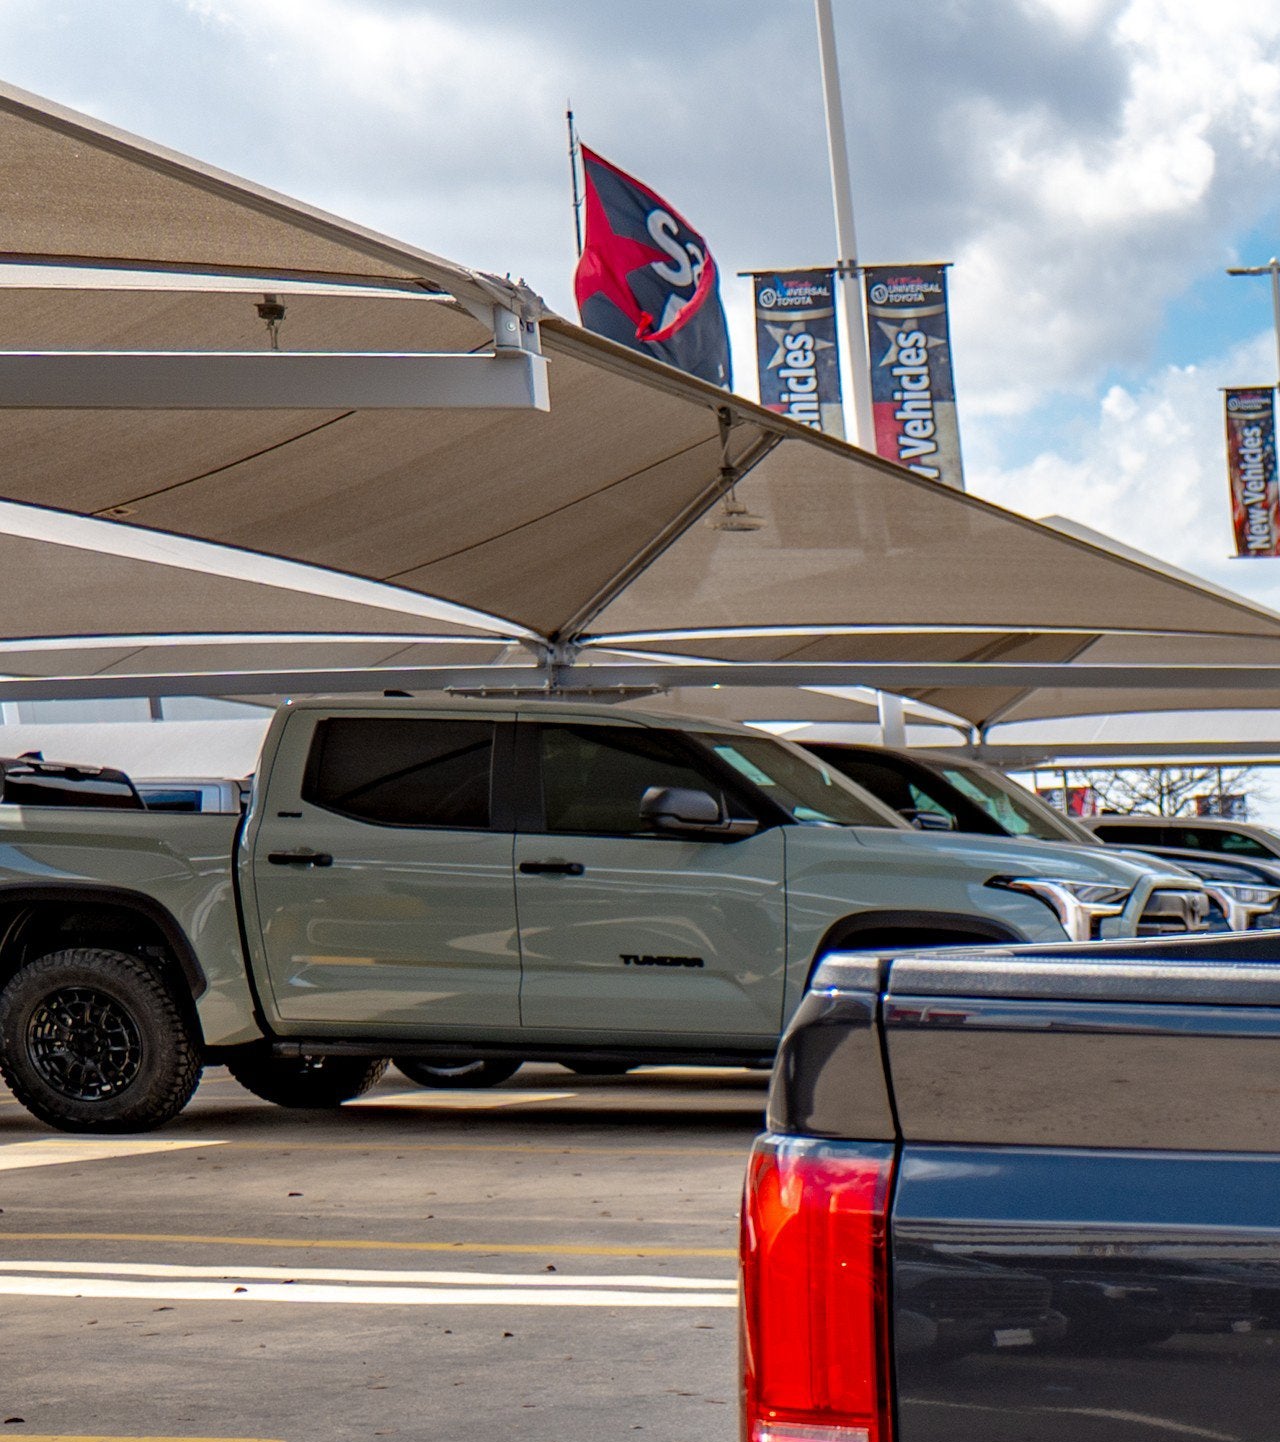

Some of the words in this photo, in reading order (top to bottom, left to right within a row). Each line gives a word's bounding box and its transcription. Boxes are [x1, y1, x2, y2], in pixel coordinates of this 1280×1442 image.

[777, 296, 813, 306] TOYOTA
[889, 292, 925, 303] TOYOTA
[779, 332, 822, 431] hicles
[892, 330, 937, 460] Vehicles
[1239, 425, 1266, 505] Vehicles
[1247, 504, 1271, 550] New
